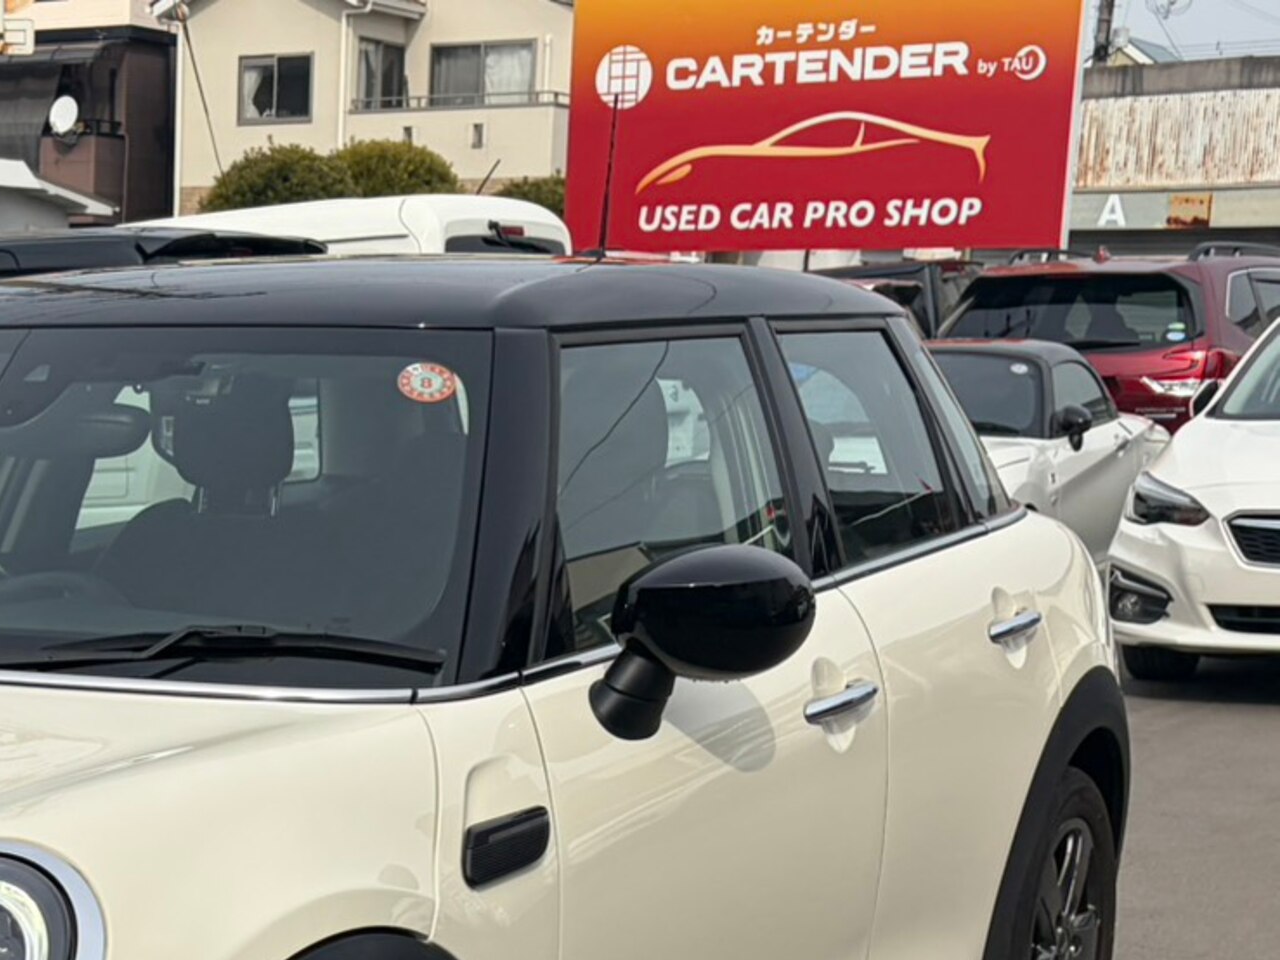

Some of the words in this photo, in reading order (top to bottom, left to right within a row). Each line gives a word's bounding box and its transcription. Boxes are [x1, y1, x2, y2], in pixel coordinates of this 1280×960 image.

[756, 20, 876, 46] カーテンダー
[666, 41, 969, 91] CARTENDER
[977, 58, 998, 78] by
[1001, 55, 1034, 72] TAU
[638, 204, 721, 232] USED
[729, 202, 794, 230] CAR
[804, 201, 875, 228] PRO
[883, 197, 982, 227] SHOP
[1097, 194, 1126, 227] A
